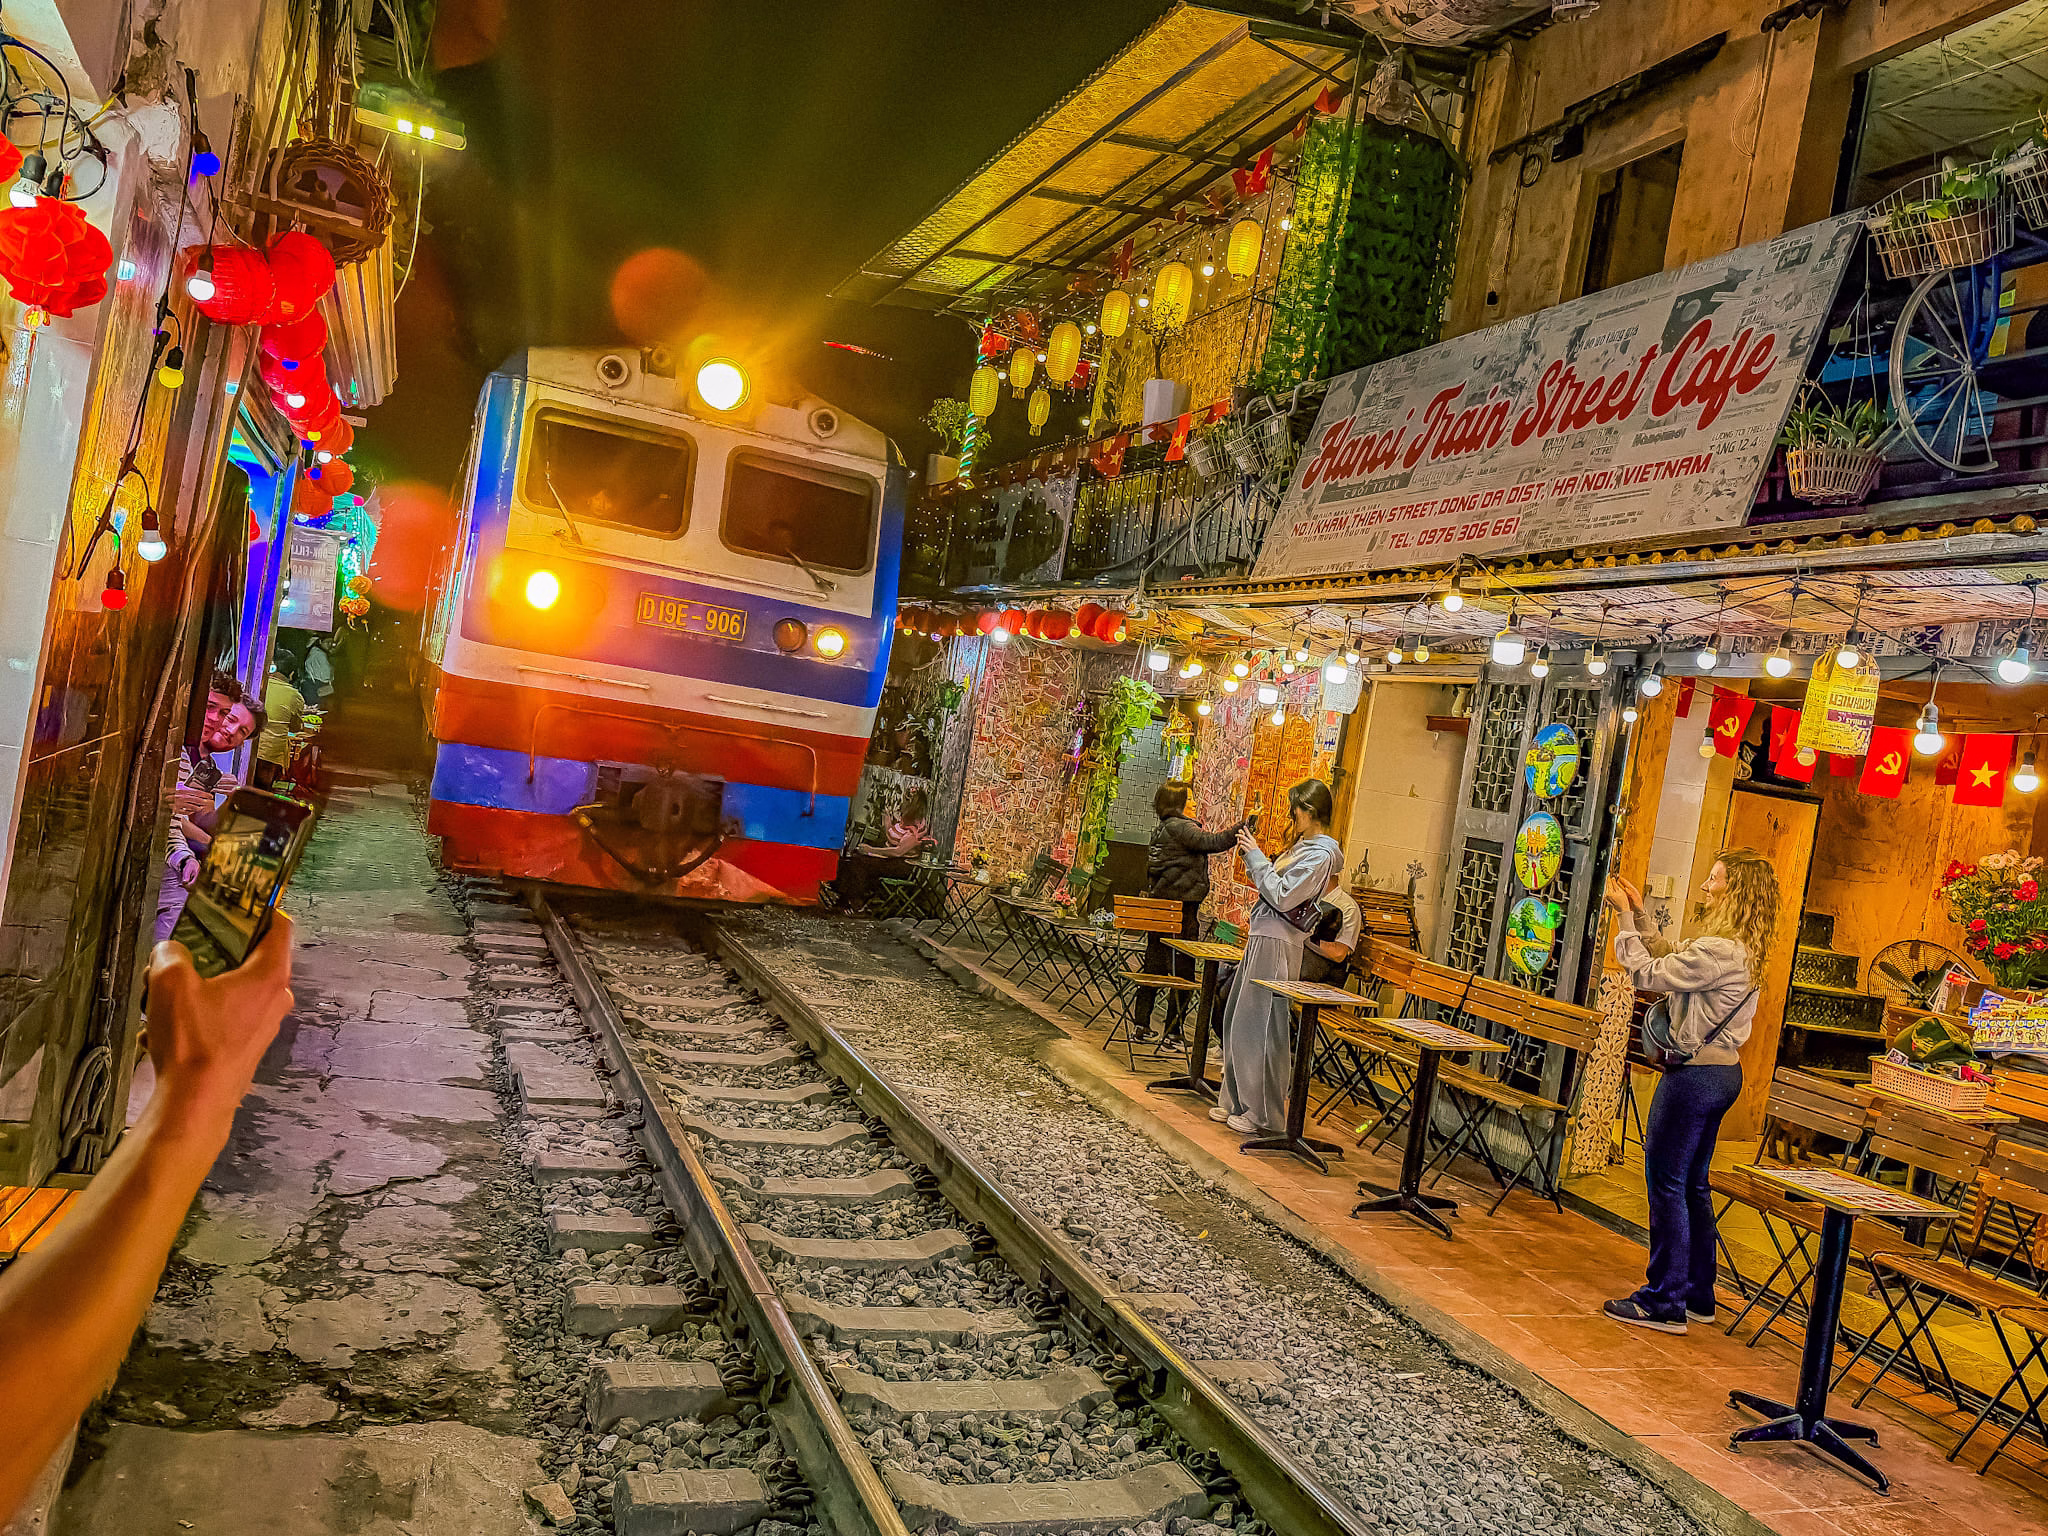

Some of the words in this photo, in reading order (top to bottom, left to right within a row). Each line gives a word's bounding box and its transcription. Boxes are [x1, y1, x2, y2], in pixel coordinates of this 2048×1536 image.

[1301, 408, 1415, 490] Hanoi
[1402, 380, 1511, 469] Train
[1511, 344, 1659, 447] Street
[1651, 319, 1779, 431] Cafe
[1316, 515, 1350, 535] KHAM
[1351, 508, 1387, 531] THIEN
[1480, 489, 1505, 509] DA
[1551, 475, 1579, 498] HA
[1623, 453, 1714, 487] VIETNAM
[1388, 531, 1414, 550] TEL:
[1416, 525, 1457, 547] 0976
[1457, 521, 1490, 542] 306
[1491, 516, 1521, 537] 661
